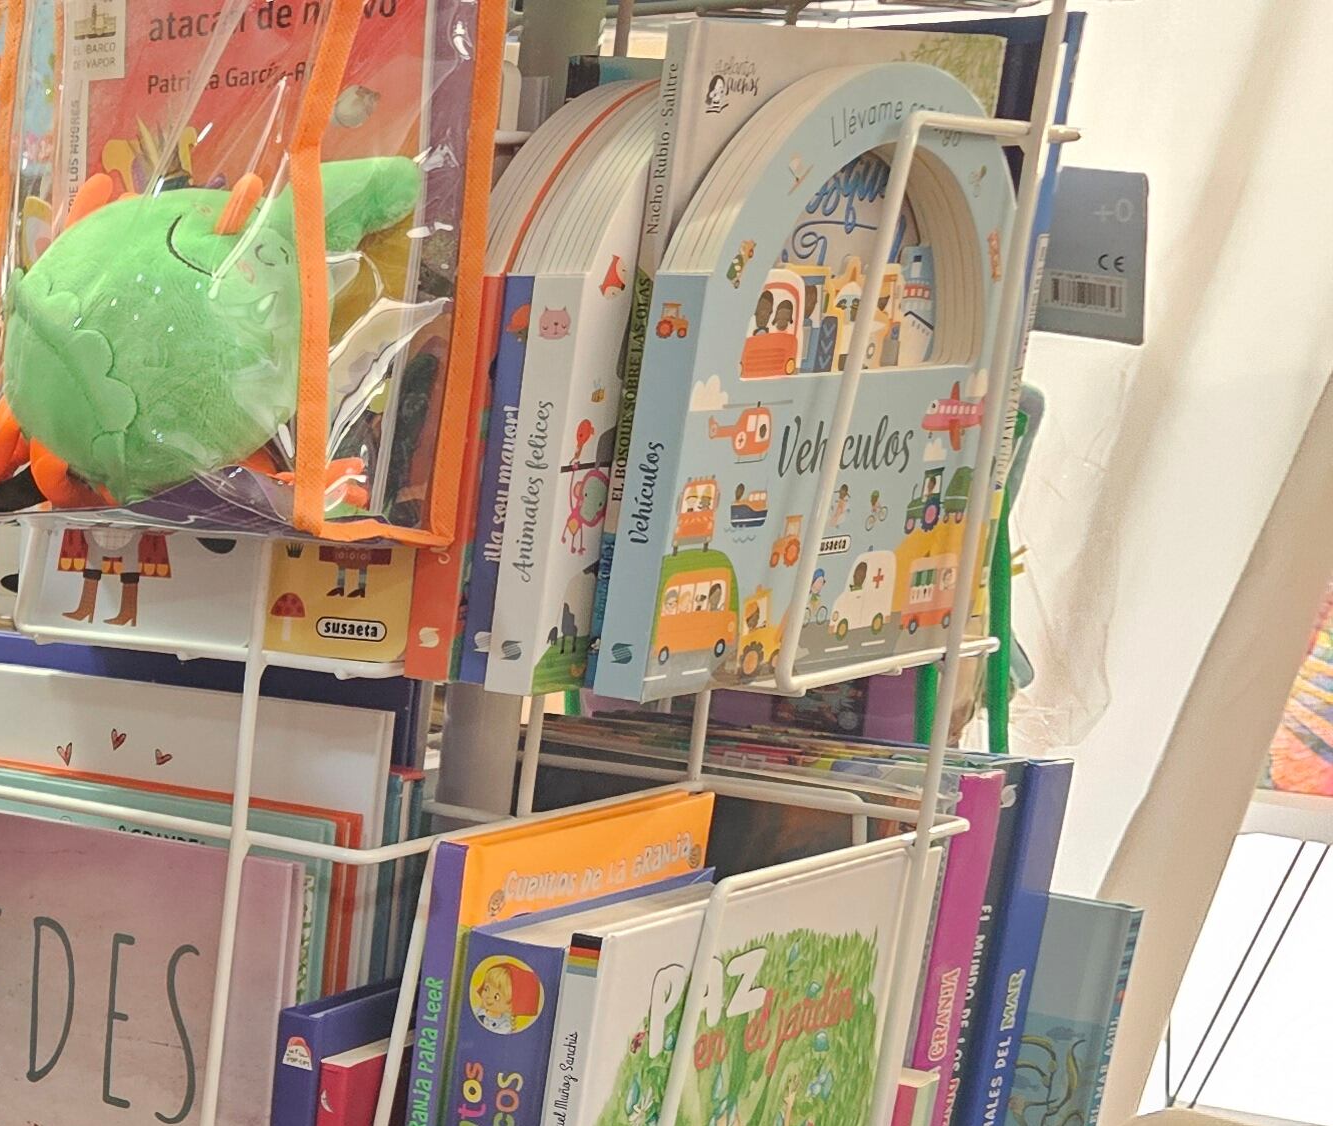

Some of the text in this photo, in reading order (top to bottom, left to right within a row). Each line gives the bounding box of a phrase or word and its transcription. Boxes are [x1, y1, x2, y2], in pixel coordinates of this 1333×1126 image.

[256, 1, 293, 30] de
[645, 61, 680, 237] Nacho Rubio Salitre
[830, 98, 906, 148] Llévame
[512, 399, 555, 584] Animales felices
[627, 440, 666, 546] Vehículos
[323, 619, 380, 640] susaeta
[692, 967, 857, 1079] en el jardín
[926, 967, 962, 1062] GRANJA
[999, 967, 1027, 1033] MAR
[993, 1035, 1013, 1070] DEL
